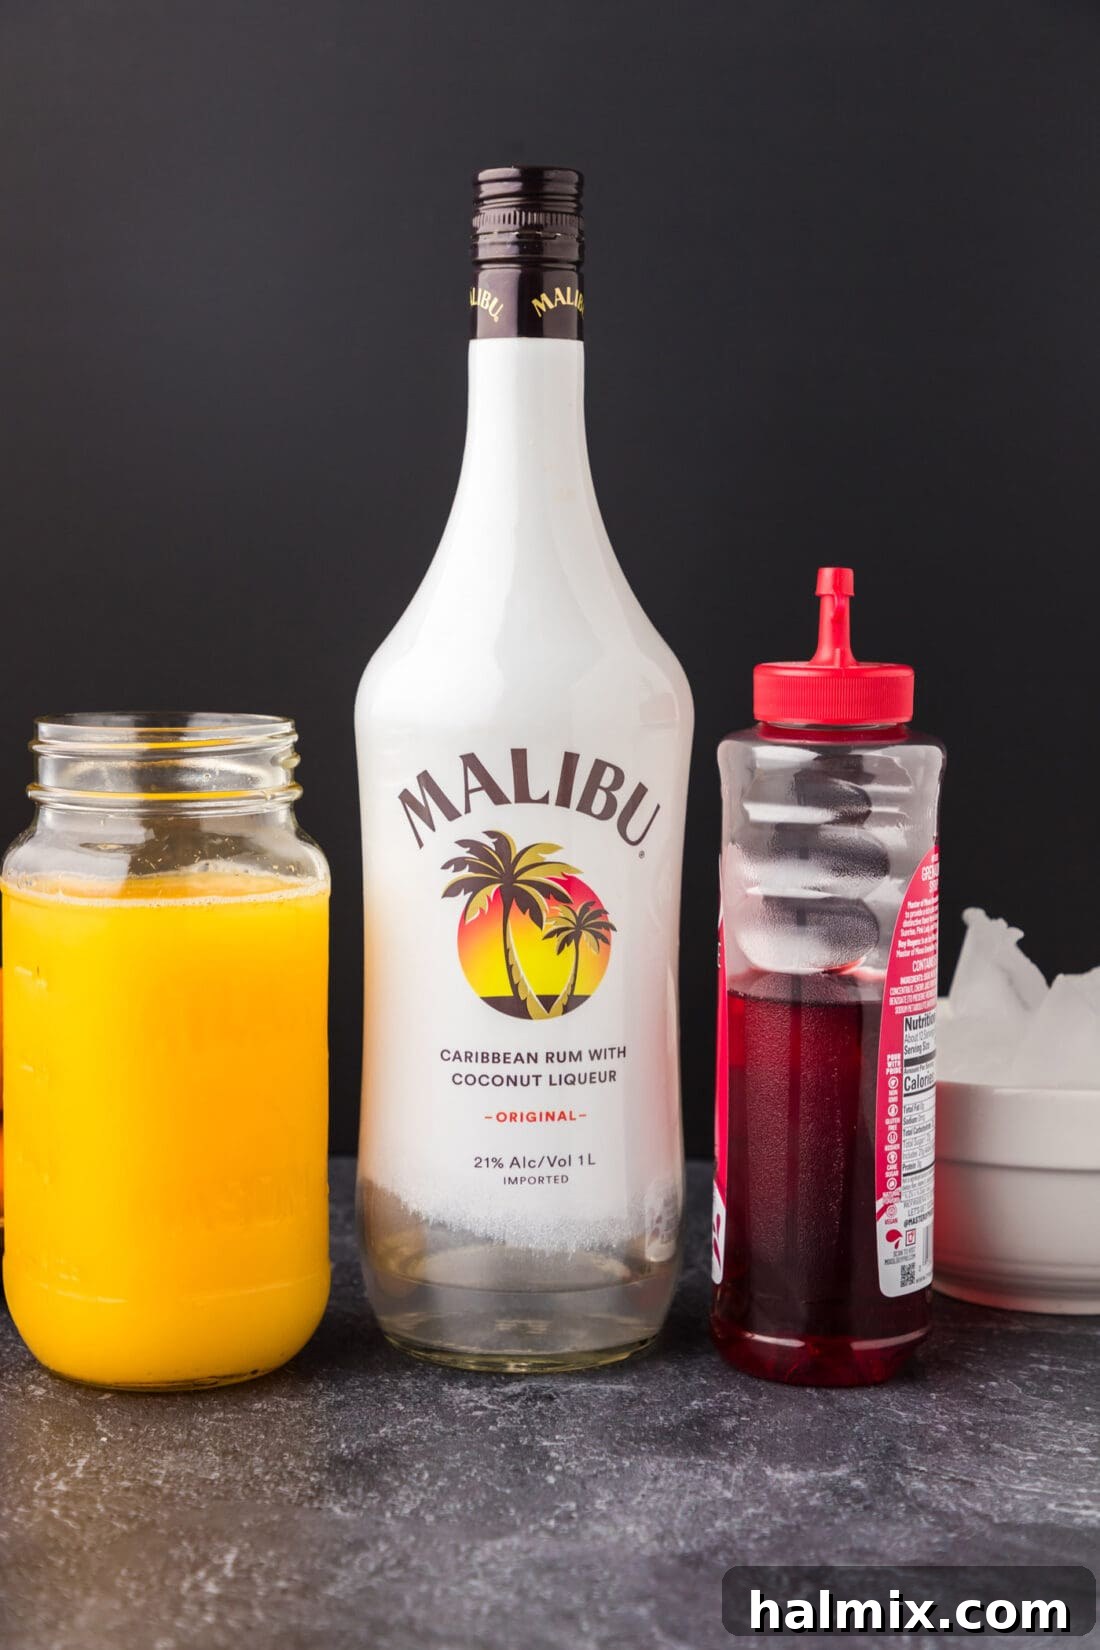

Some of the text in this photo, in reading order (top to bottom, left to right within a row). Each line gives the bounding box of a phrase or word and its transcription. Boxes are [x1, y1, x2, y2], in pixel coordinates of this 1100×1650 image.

[470, 287, 504, 318] LIBU
[531, 286, 584, 318] MALIB
[398, 747, 661, 850] MALIBU
[440, 1046, 627, 1064] CARIBBEAN RUM WITH
[451, 1070, 617, 1087] COCONUT LIQUEUR
[473, 1156, 504, 1169] 21%
[509, 1154, 572, 1169] Alc/Vol
[503, 1174, 569, 1185] IMPORTED
